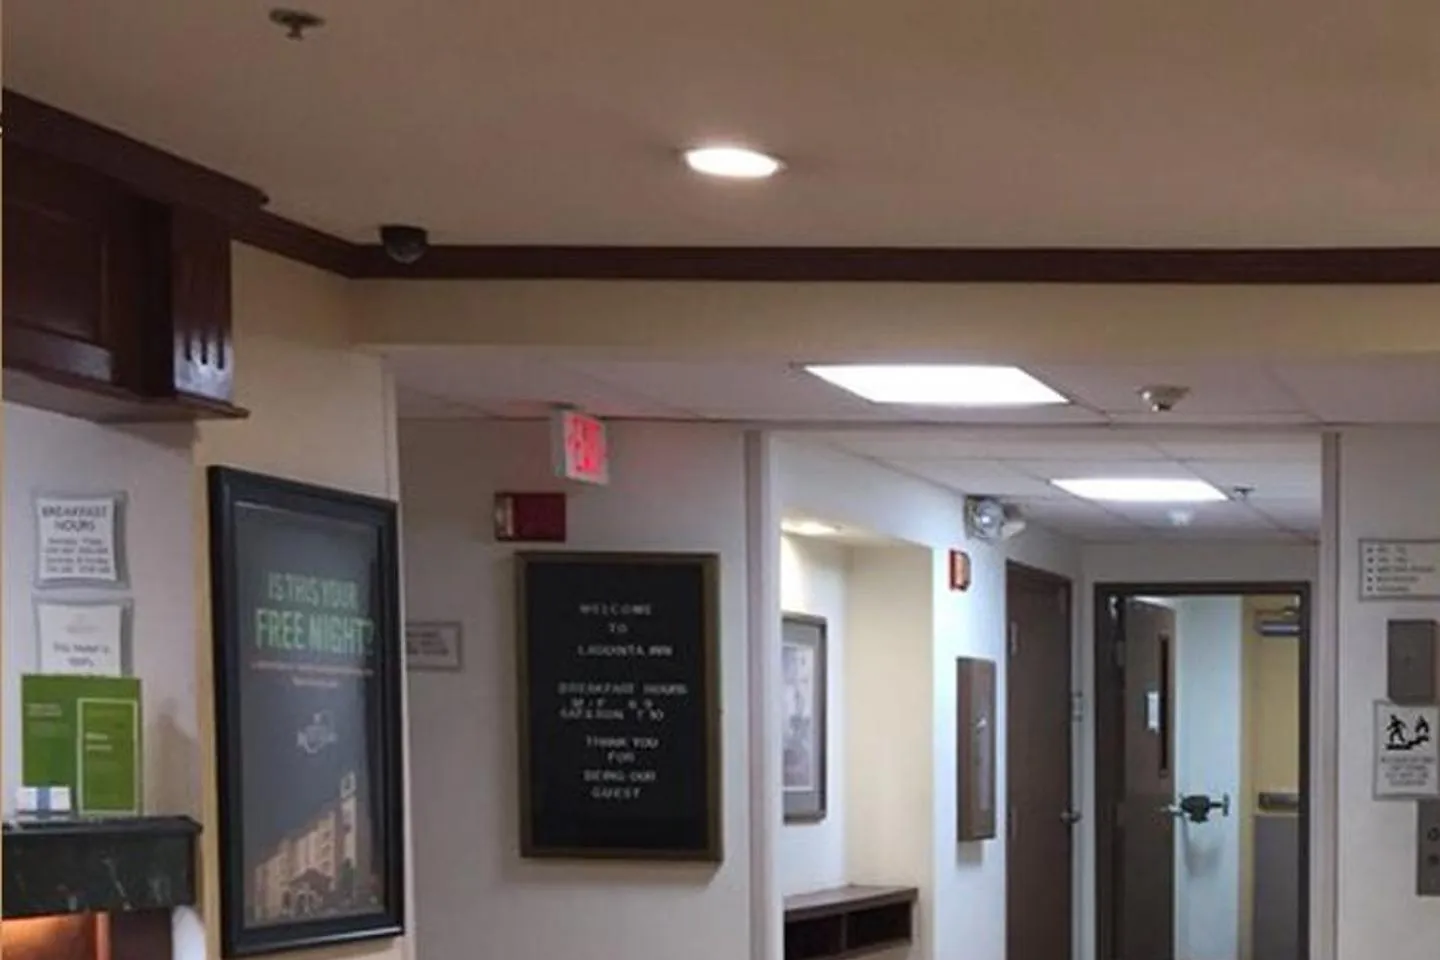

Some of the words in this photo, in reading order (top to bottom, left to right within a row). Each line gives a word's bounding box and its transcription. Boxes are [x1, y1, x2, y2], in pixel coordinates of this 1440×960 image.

[42, 505, 107, 518] BREAKFAST
[54, 519, 96, 532] HOURS
[579, 603, 652, 616] WELCOME
[255, 607, 306, 650] FREE
[308, 612, 375, 656] NIGHT?
[608, 622, 628, 633] TO
[558, 682, 634, 694] BREAKFAST
[632, 736, 660, 748] YOU
